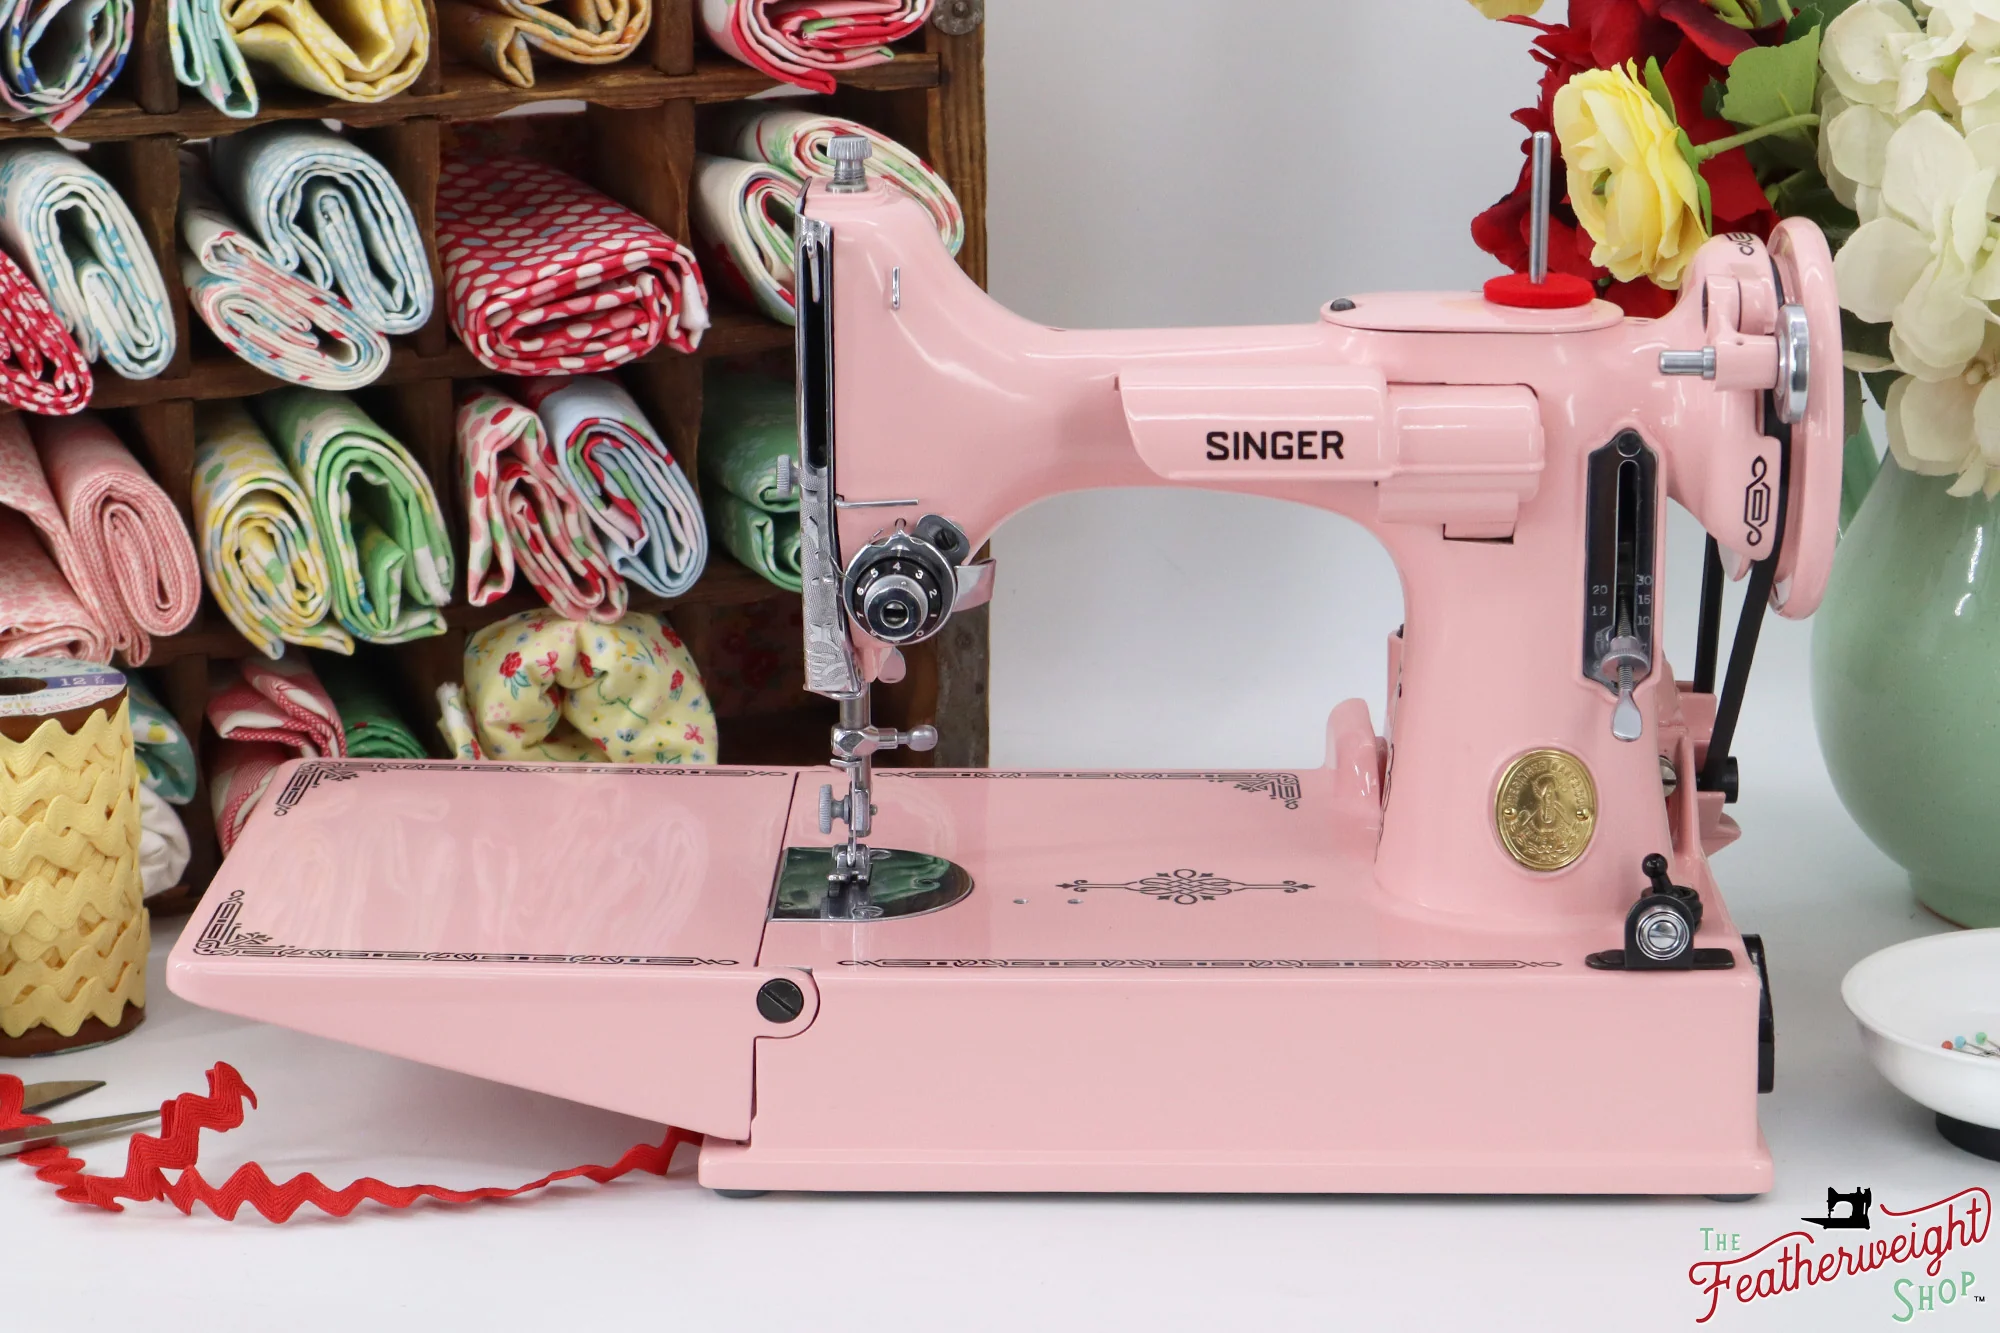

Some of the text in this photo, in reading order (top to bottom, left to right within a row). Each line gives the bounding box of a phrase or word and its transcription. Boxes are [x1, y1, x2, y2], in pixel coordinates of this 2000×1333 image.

[1206, 430, 1345, 461] SINGER
[856, 587, 864, 596] 6
[871, 568, 878, 578] 5
[893, 562, 901, 571] 4
[915, 570, 924, 580] 3
[929, 589, 937, 598] 2
[1636, 574, 1653, 586] 30
[1592, 585, 1608, 595] 20
[1638, 594, 1651, 605] 15
[1592, 605, 1607, 616] 12
[1637, 615, 1651, 626] 10
[60, 676, 87, 687] 12
